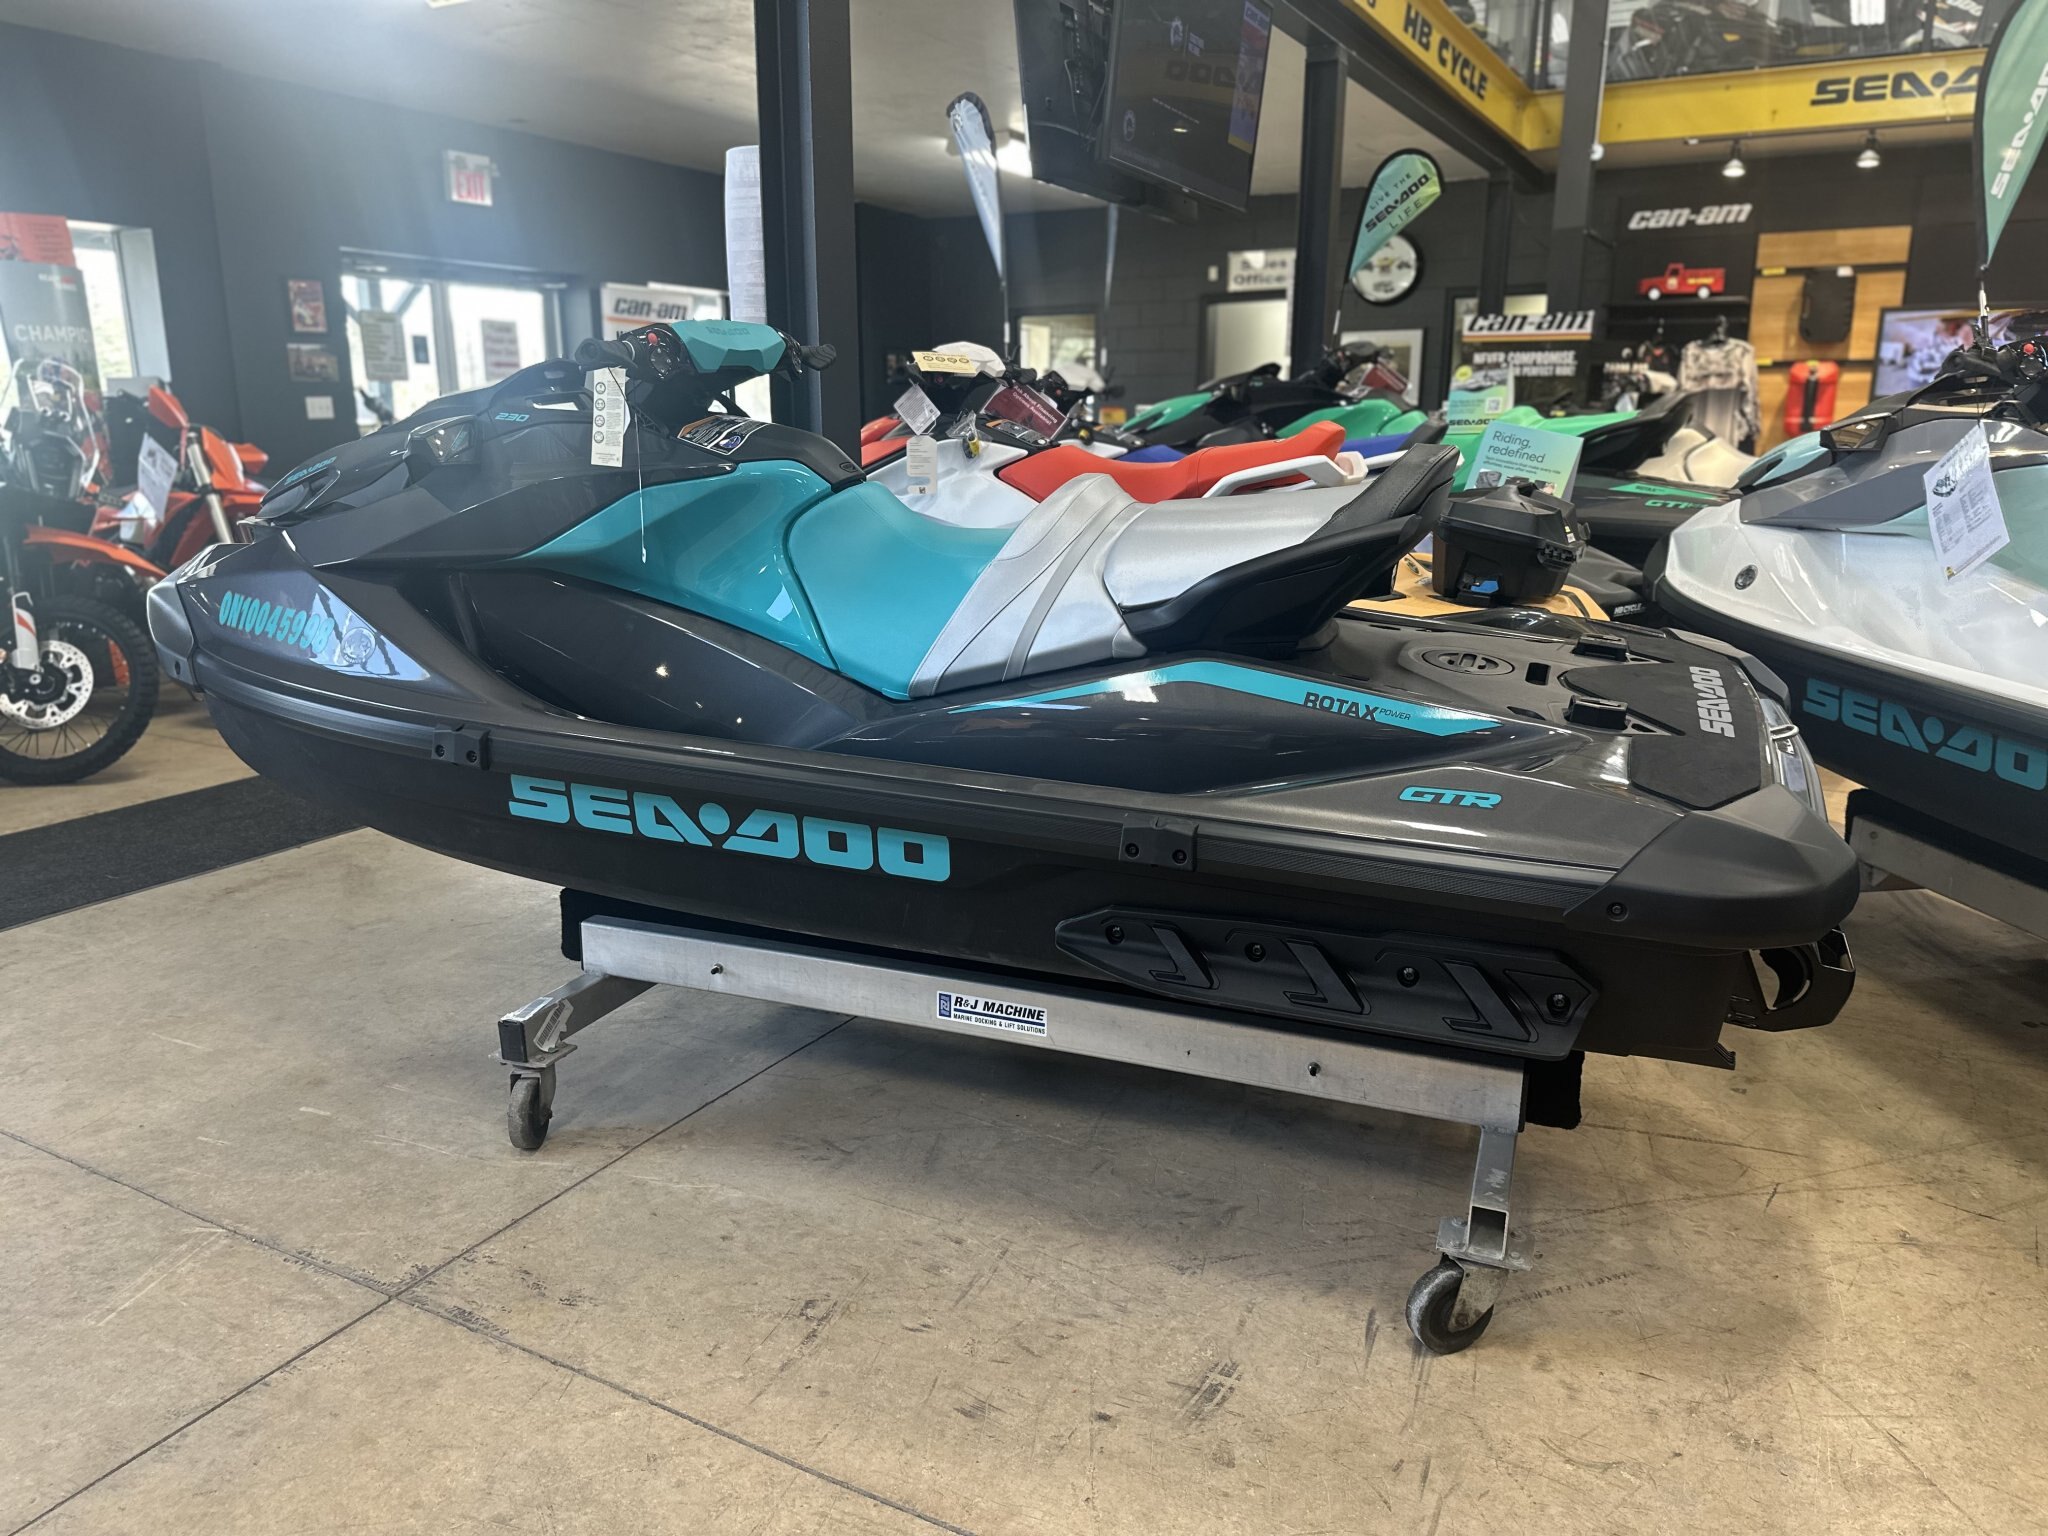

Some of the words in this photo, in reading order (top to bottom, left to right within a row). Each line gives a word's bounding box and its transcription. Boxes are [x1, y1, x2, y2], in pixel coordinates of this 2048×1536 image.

[1404, 2, 1432, 51] HB
[1438, 37, 1487, 100] CYCLE
[455, 171, 485, 201] EXIT
[1369, 191, 1391, 211] LIVE
[1394, 172, 1412, 189] THE
[1389, 199, 1424, 230] LIFE
[1627, 202, 1753, 231] can-am
[1240, 259, 1287, 271] Sles
[1233, 273, 1286, 286] Office
[613, 297, 688, 320] can-am
[1468, 311, 1594, 332] can-am
[495, 412, 530, 422] 230
[1493, 430, 1532, 451] Riding,
[1488, 445, 1546, 464] redefined
[1645, 499, 1690, 509] GTI
[219, 590, 335, 653] ON10045998
[1304, 691, 1380, 721] ROTAX
[1379, 707, 1411, 721] POWER
[1399, 784, 1502, 810] GTR
[954, 996, 979, 1010] R&J
[983, 1000, 1046, 1022] MACHINE
[953, 1013, 972, 1022] MARINE
[974, 1016, 997, 1027] DOCKING
[1004, 1022, 1016, 1030] LIFT
[1016, 1024, 1046, 1035] SOLUTIONS
